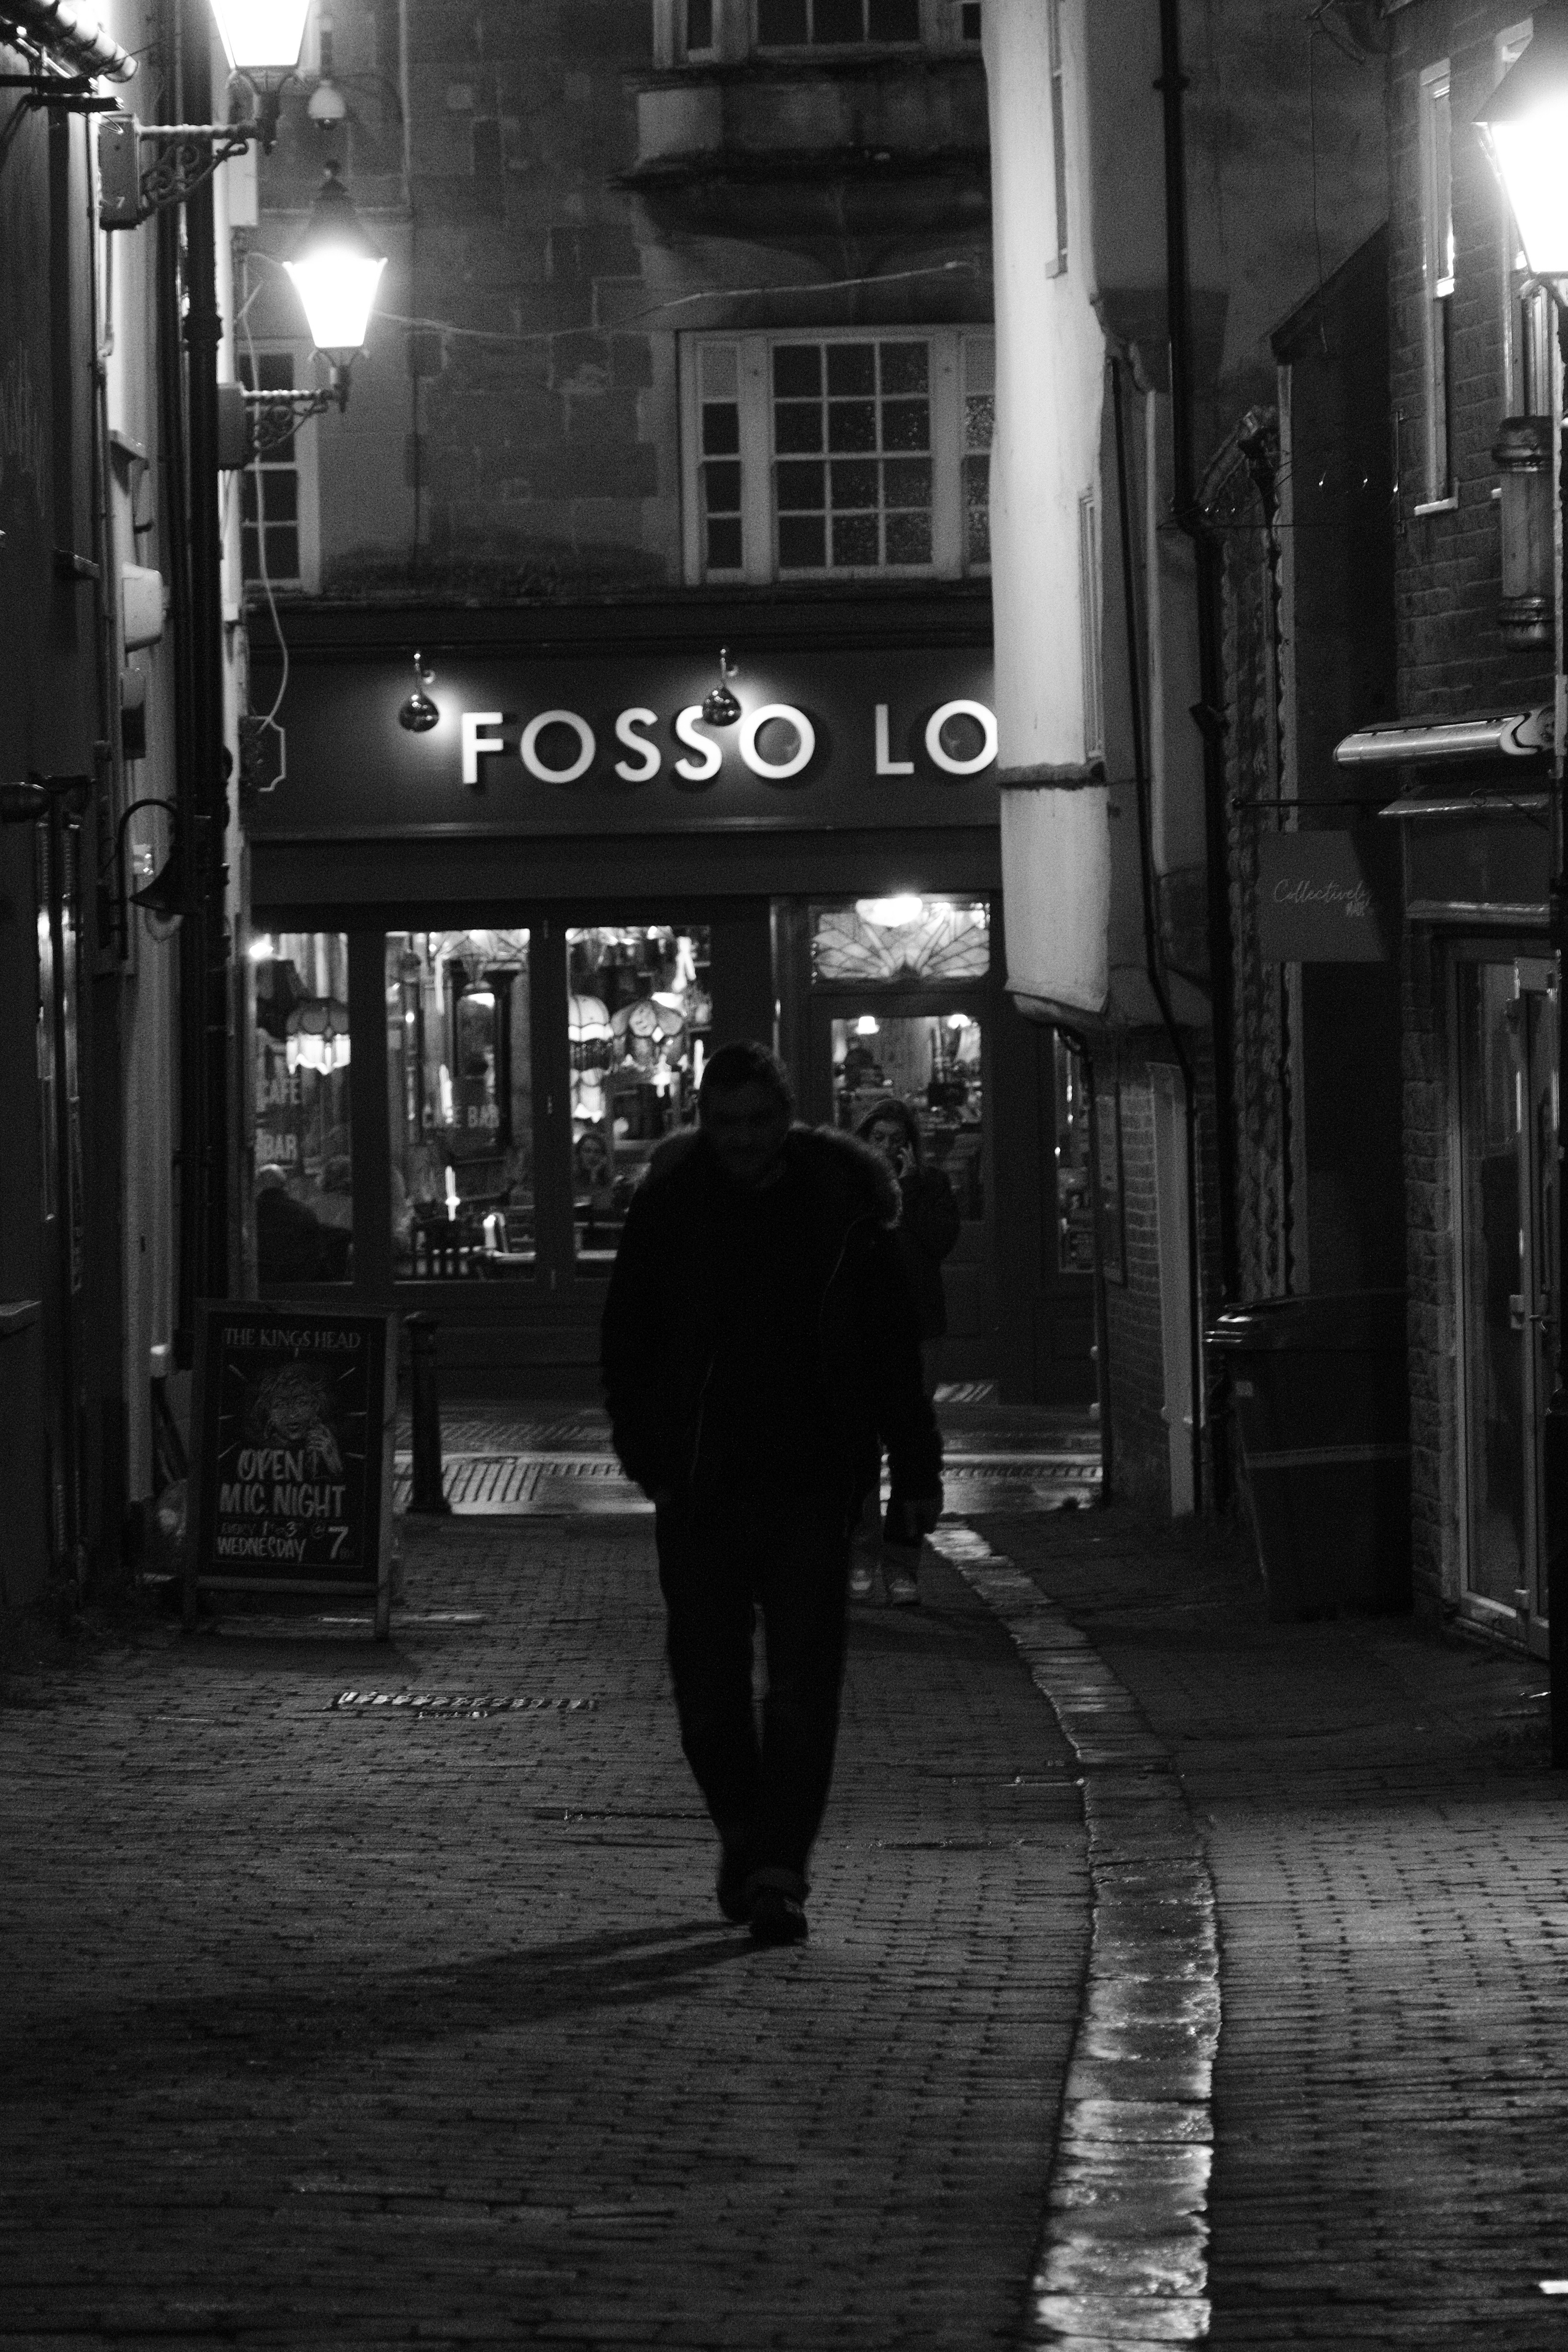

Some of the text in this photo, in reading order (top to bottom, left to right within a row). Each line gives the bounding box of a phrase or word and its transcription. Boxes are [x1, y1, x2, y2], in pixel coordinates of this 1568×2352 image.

[462, 703, 815, 784] FOSSO
[224, 1327, 255, 1346] THE
[314, 1330, 361, 1349] HEAD
[238, 1448, 305, 1482] OPEN
[272, 1482, 346, 1518] NIGHT
[217, 1536, 307, 1563] WEDNESDAY
[328, 1525, 350, 1560] 7
